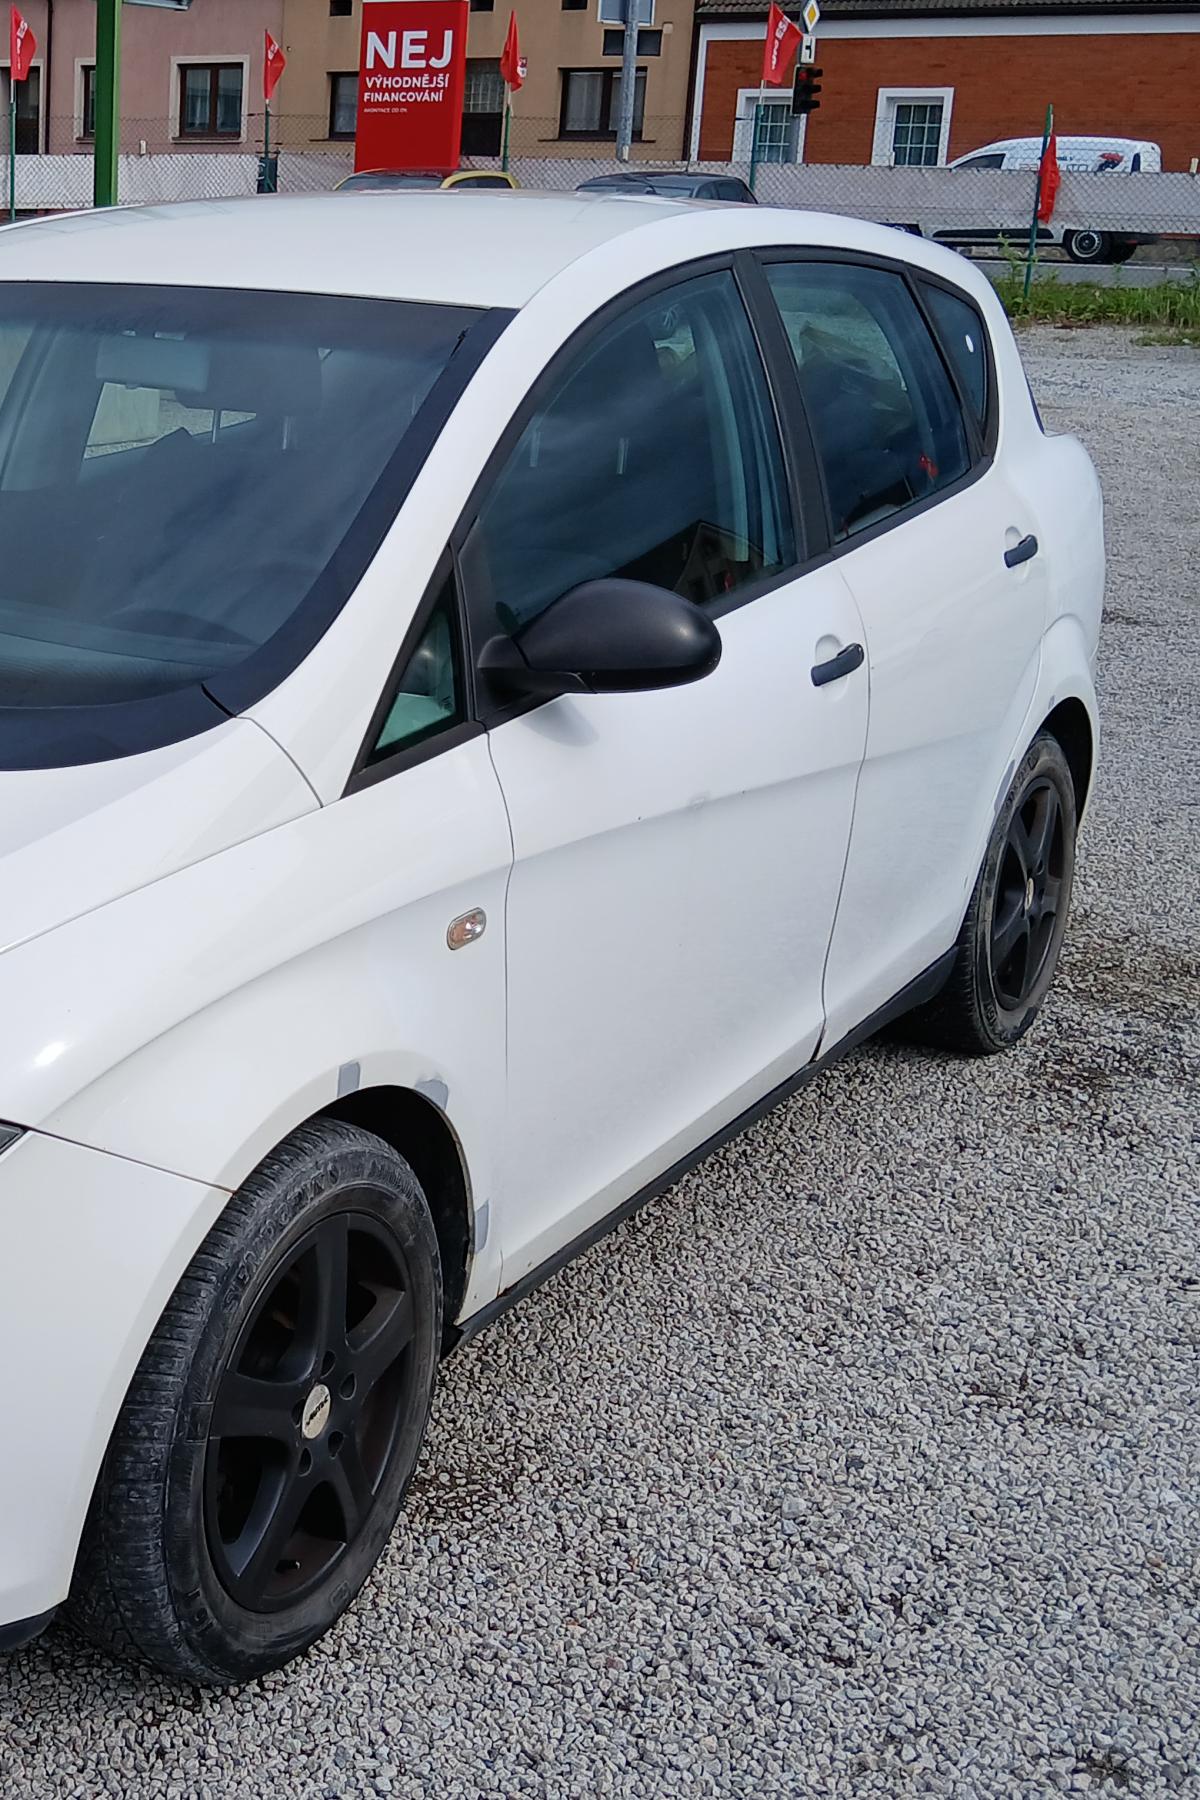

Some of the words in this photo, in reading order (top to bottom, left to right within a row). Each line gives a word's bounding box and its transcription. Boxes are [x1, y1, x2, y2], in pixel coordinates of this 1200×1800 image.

[366, 29, 453, 69] NEJ
[365, 73, 449, 88] VÝHODNĚJŠÍ
[363, 89, 444, 102] FINANCOVÁNÍ
